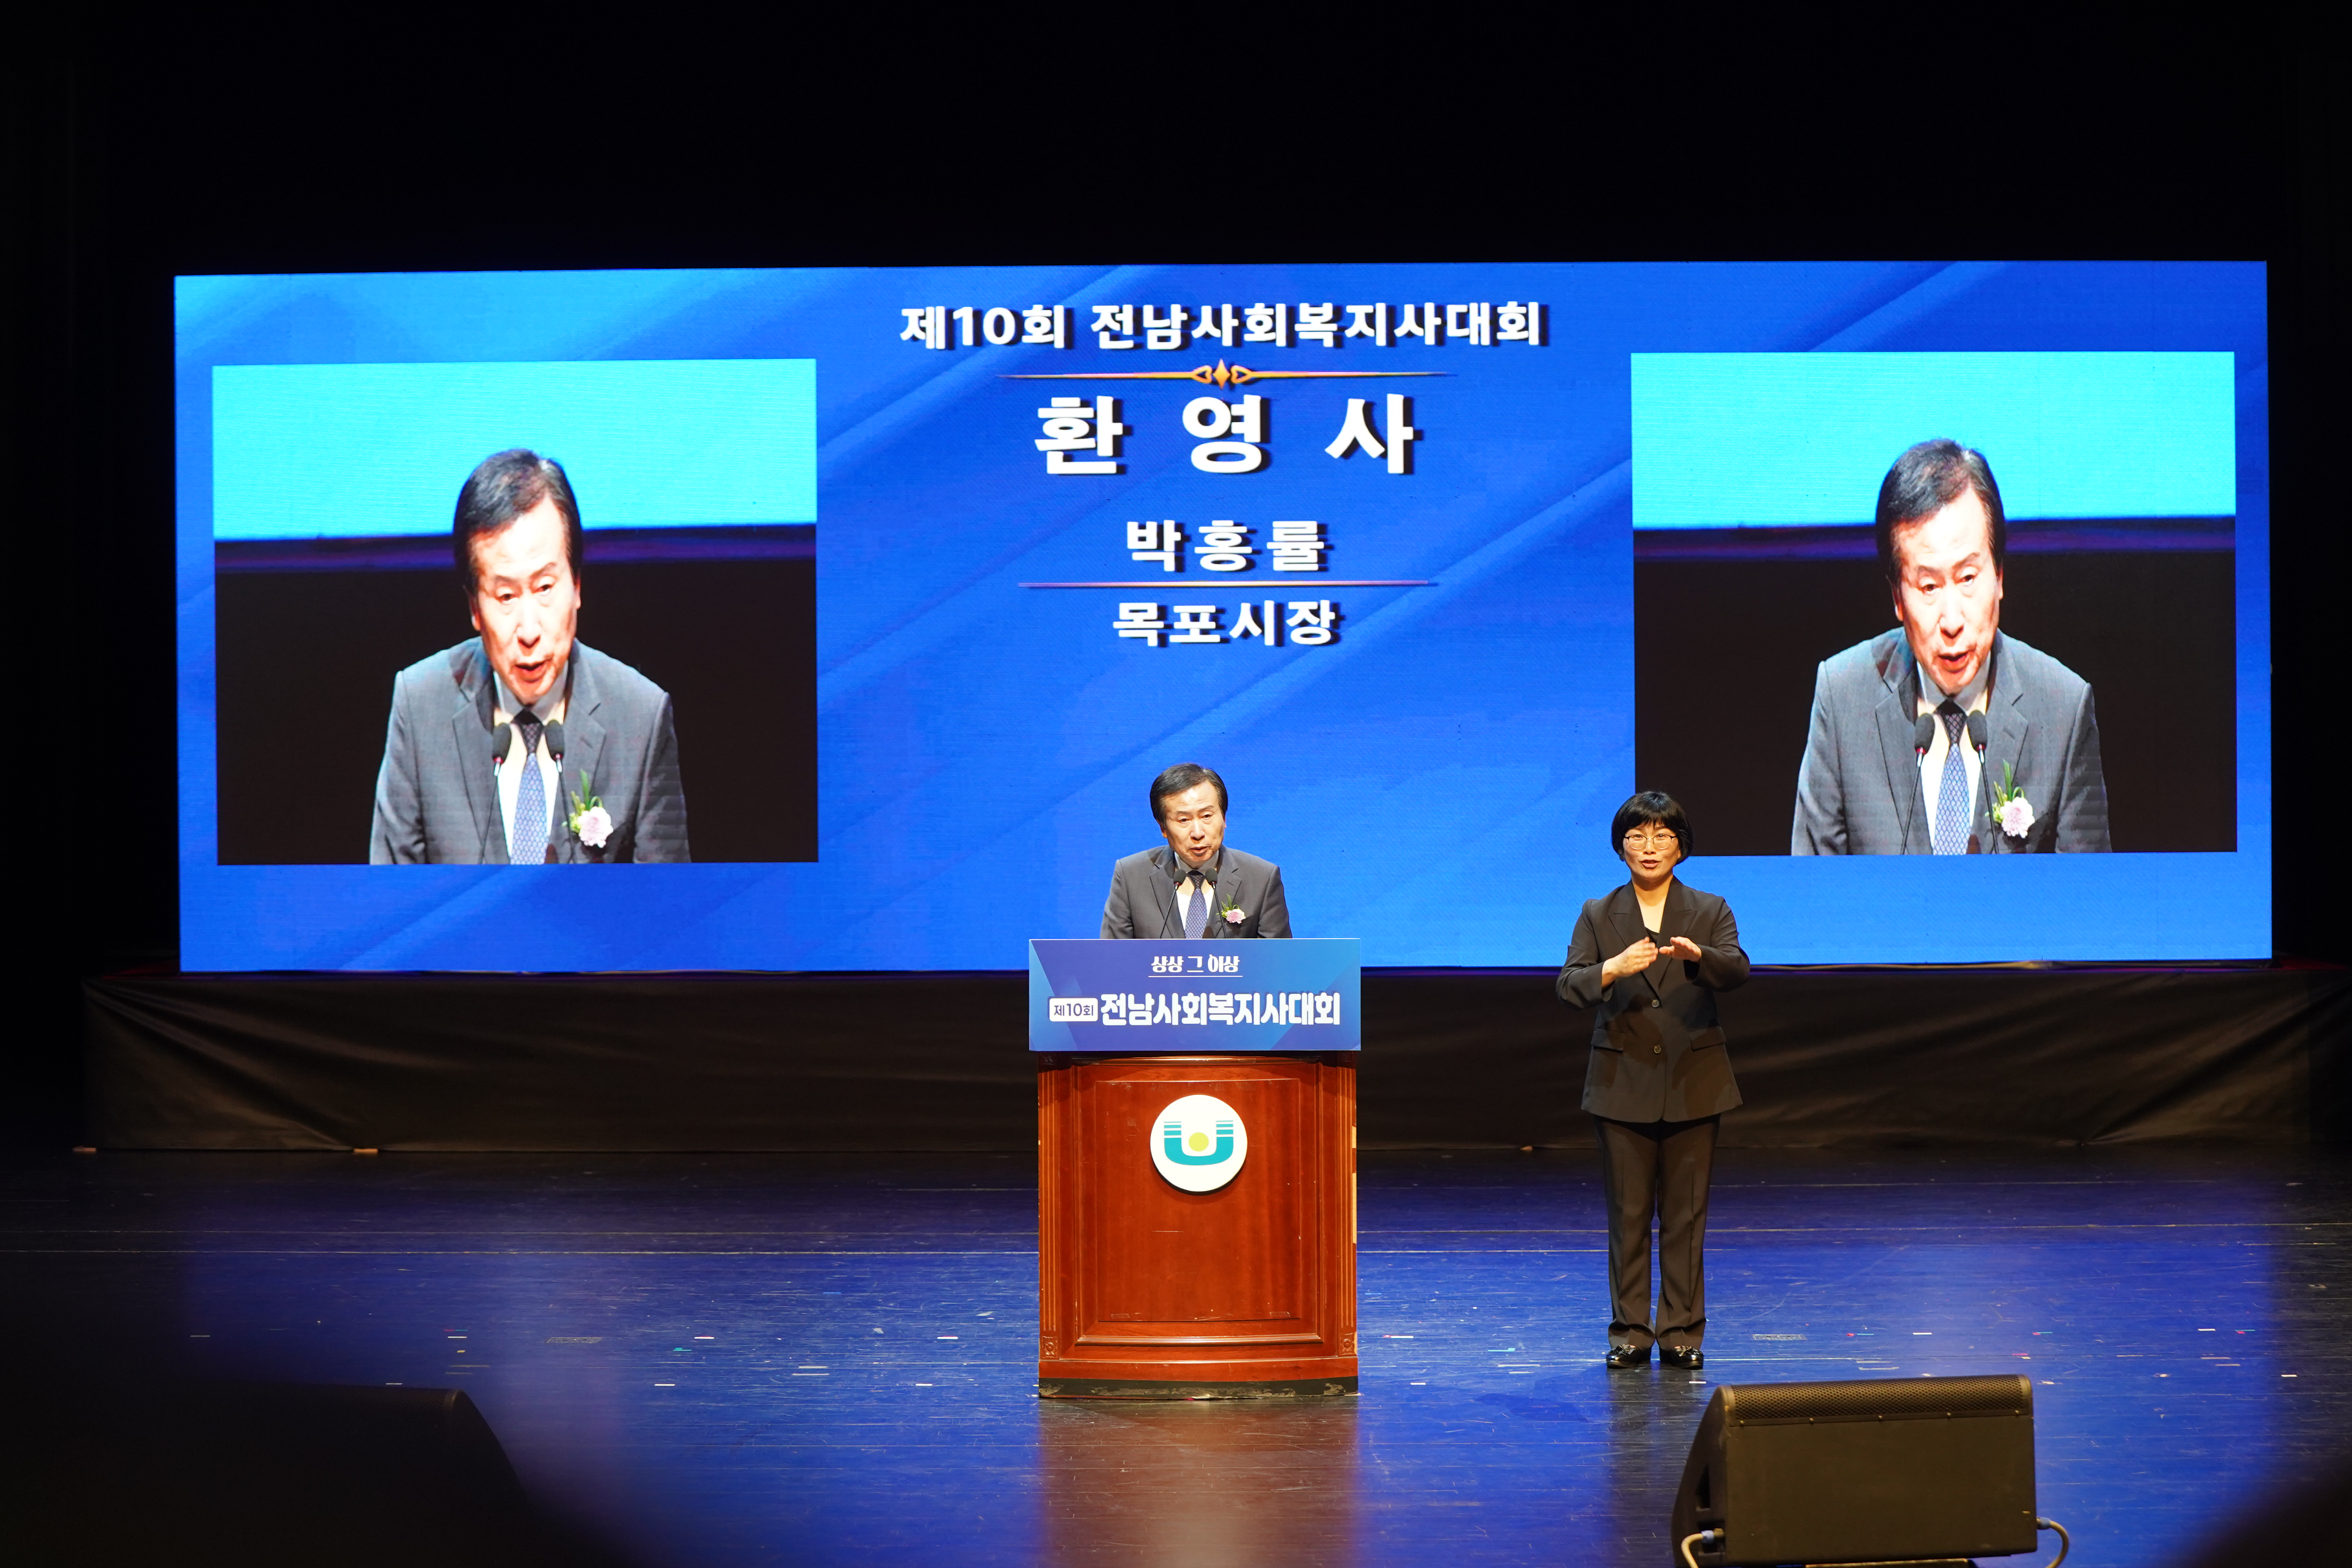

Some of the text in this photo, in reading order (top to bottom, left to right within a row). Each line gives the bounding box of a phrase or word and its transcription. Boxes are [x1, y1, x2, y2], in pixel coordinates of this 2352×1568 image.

[900, 301, 1539, 349] 제10회 전남사회복지사대회
[1127, 520, 1324, 571] 박홍률
[1113, 600, 1335, 646] 목포시장
[1151, 954, 1240, 973] 상상 그 이상
[1054, 993, 1340, 1025] 제10회 전남사회복지사대회
